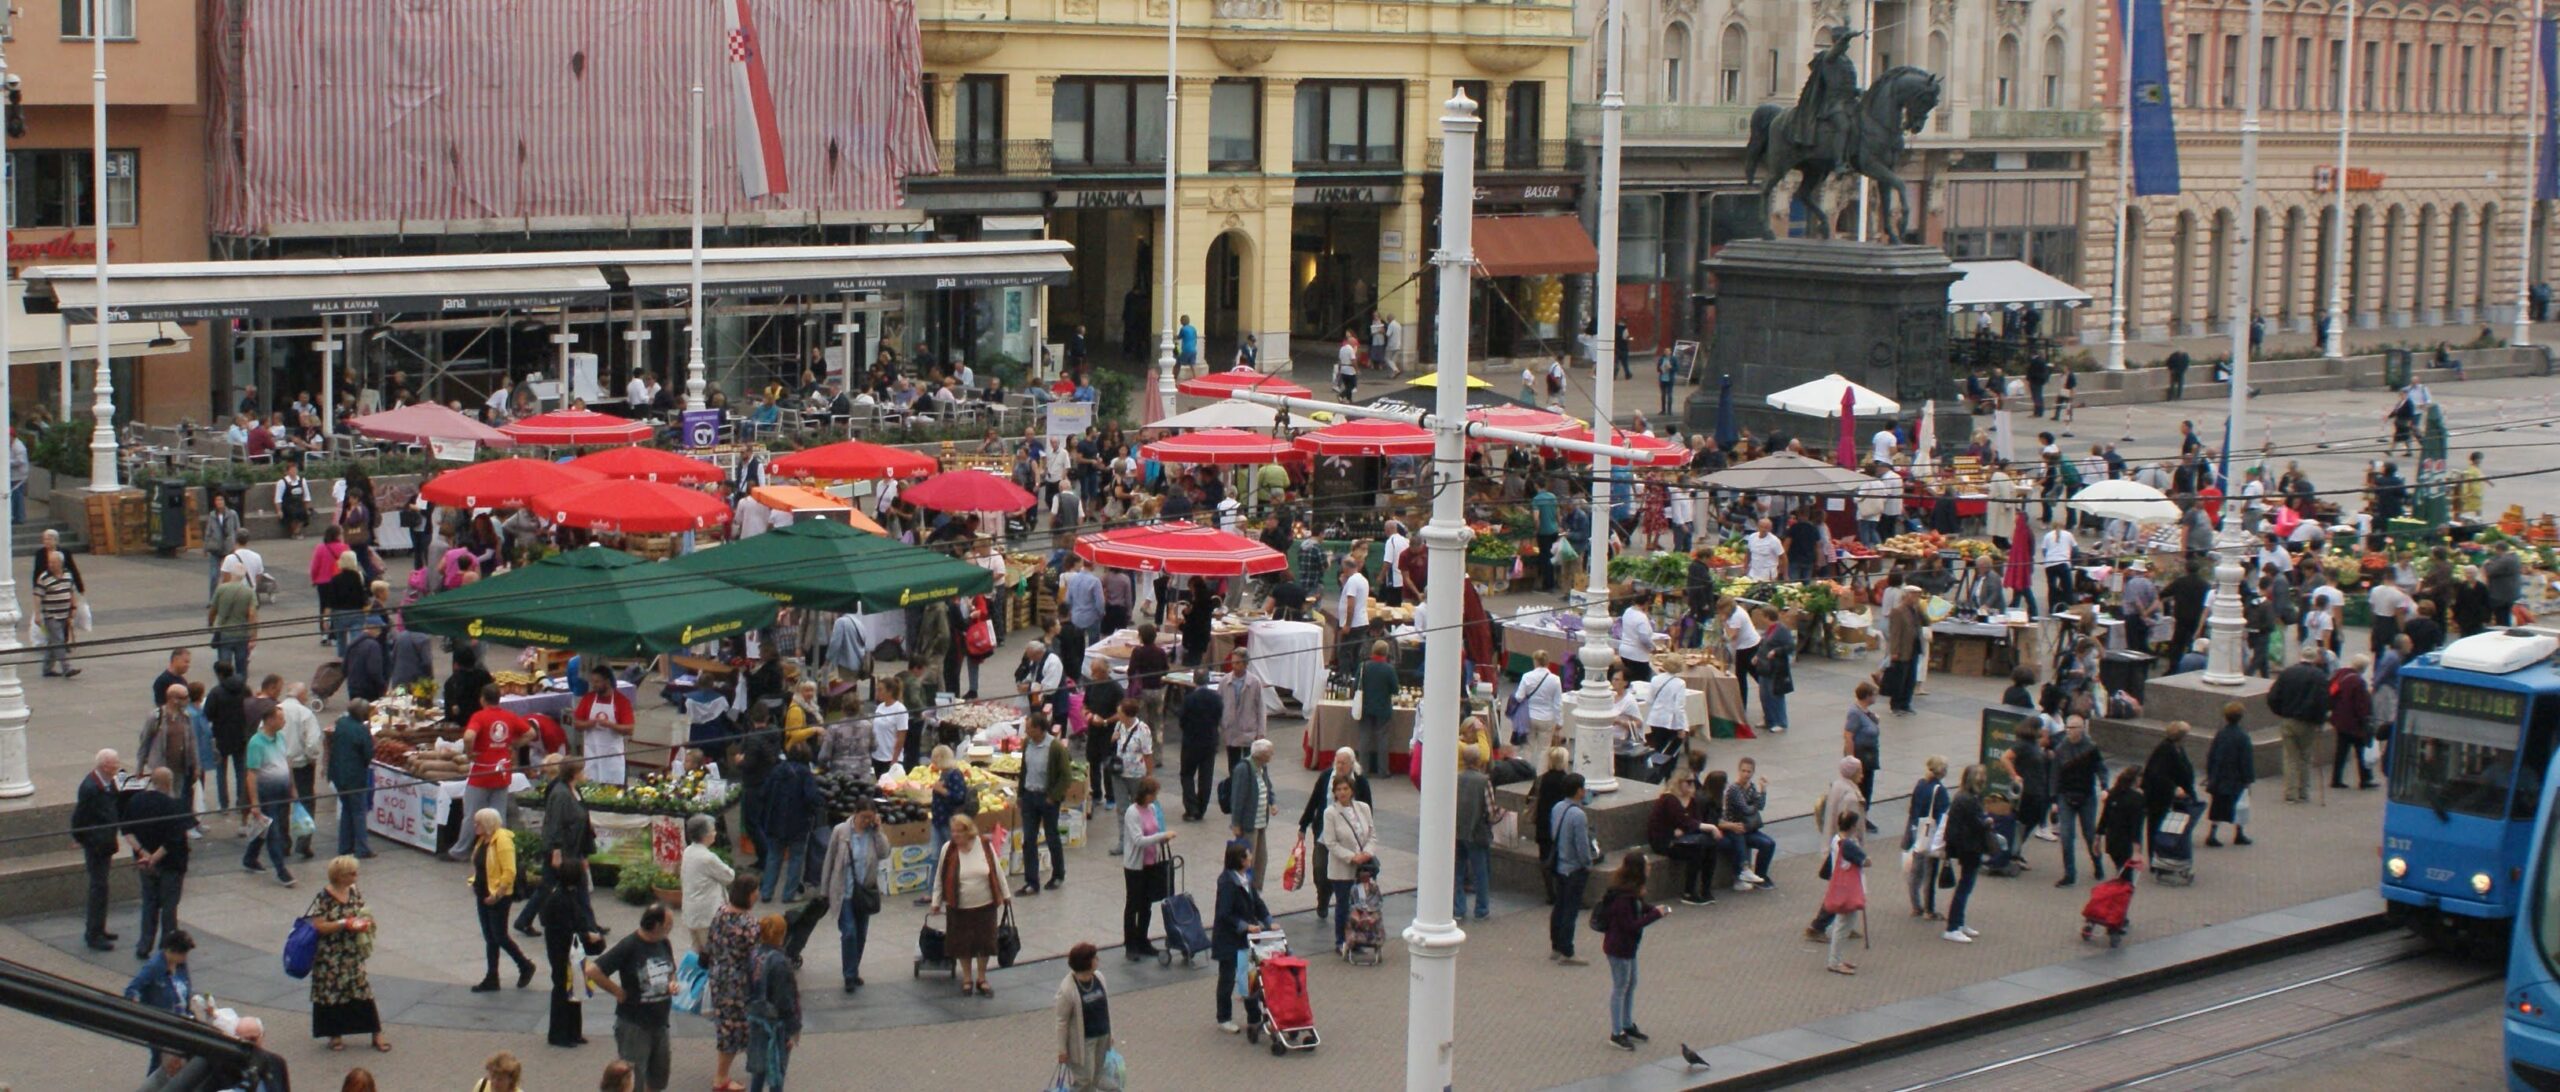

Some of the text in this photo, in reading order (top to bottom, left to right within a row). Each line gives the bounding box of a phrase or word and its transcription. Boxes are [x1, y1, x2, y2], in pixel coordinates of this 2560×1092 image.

[1077, 190, 1144, 208] HARMICA
[1314, 187, 1374, 203] HARMICA
[1524, 185, 1561, 199] BASLER
[833, 279, 887, 289] MALA KAVANA
[702, 288, 728, 297] ATURAL
[312, 300, 380, 311] MALA KAVANA
[477, 299, 512, 307] NATURAL
[513, 297, 548, 306] MINERAL
[106, 307, 250, 321] ana NATURAL MINERAL WATER
[383, 795, 407, 811] KOD
[376, 807, 416, 836] BAJE
